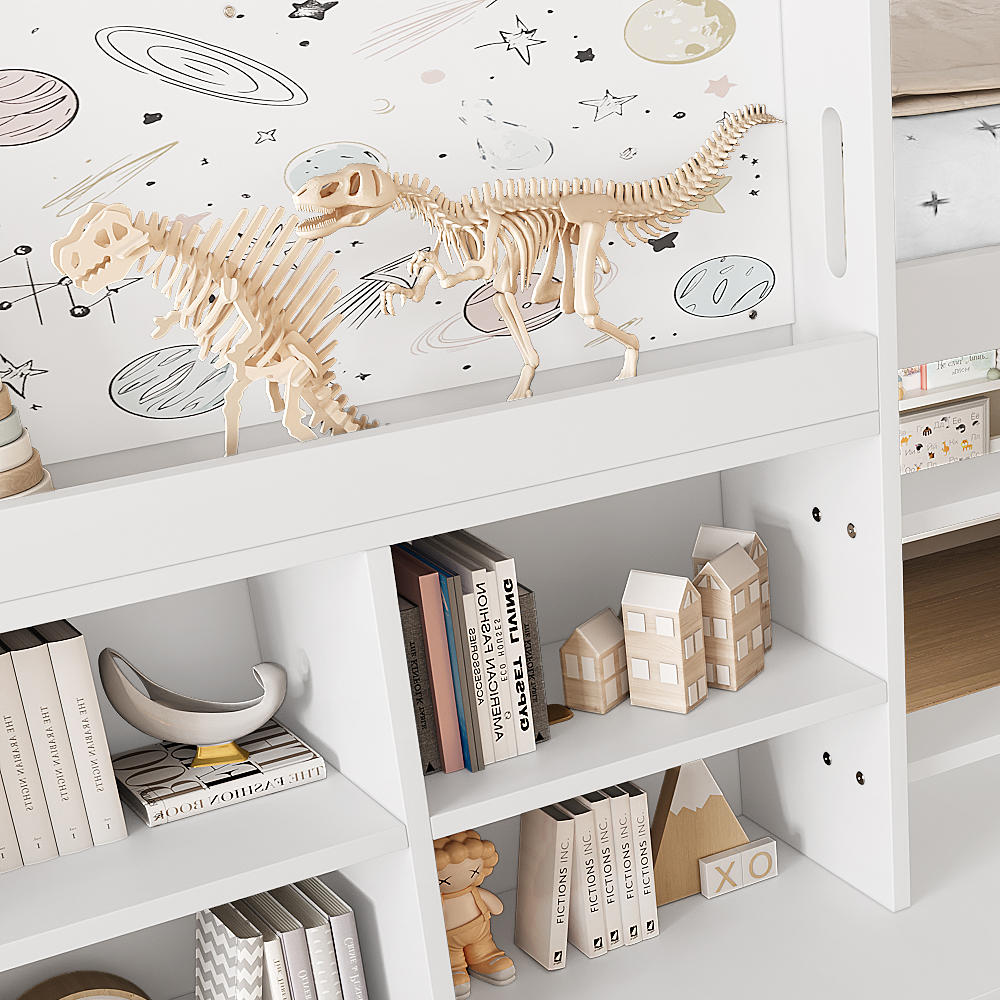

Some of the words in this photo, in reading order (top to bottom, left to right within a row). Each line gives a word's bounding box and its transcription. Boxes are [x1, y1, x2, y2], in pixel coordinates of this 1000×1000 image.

[582, 830, 592, 856] INC.
[598, 818, 609, 844] INC.
[619, 813, 628, 839] INC.
[636, 812, 646, 837] INC.
[560, 838, 570, 864] INC.
[622, 842, 634, 900] FICTIONS
[640, 840, 652, 895] FICTIONS
[556, 867, 568, 924] FICTIONS
[584, 858, 599, 914] FICTIONS
[602, 847, 615, 904] FICTIONS
